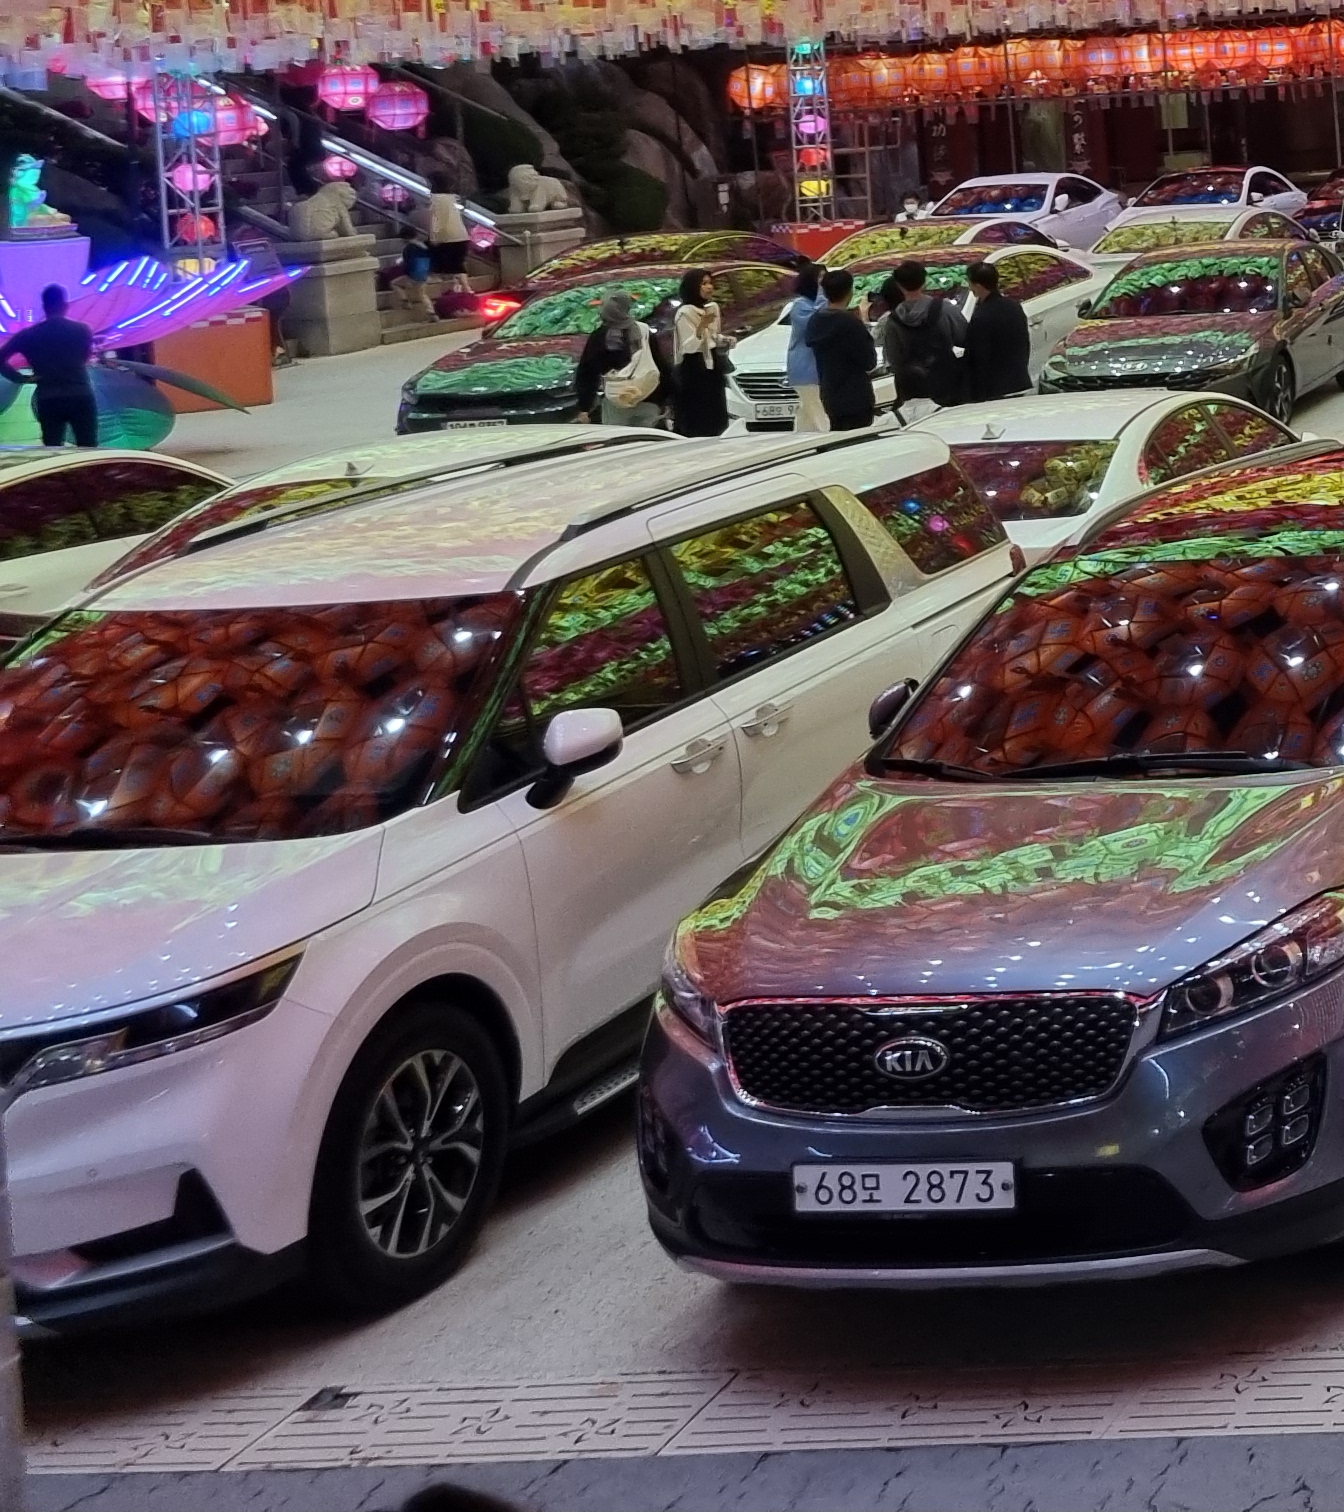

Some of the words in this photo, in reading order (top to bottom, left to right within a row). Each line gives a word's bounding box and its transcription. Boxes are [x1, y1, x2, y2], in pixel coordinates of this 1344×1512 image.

[885, 1050, 934, 1072] KIA
[813, 1171, 883, 1206] 68모
[901, 1168, 995, 1205] 2873
